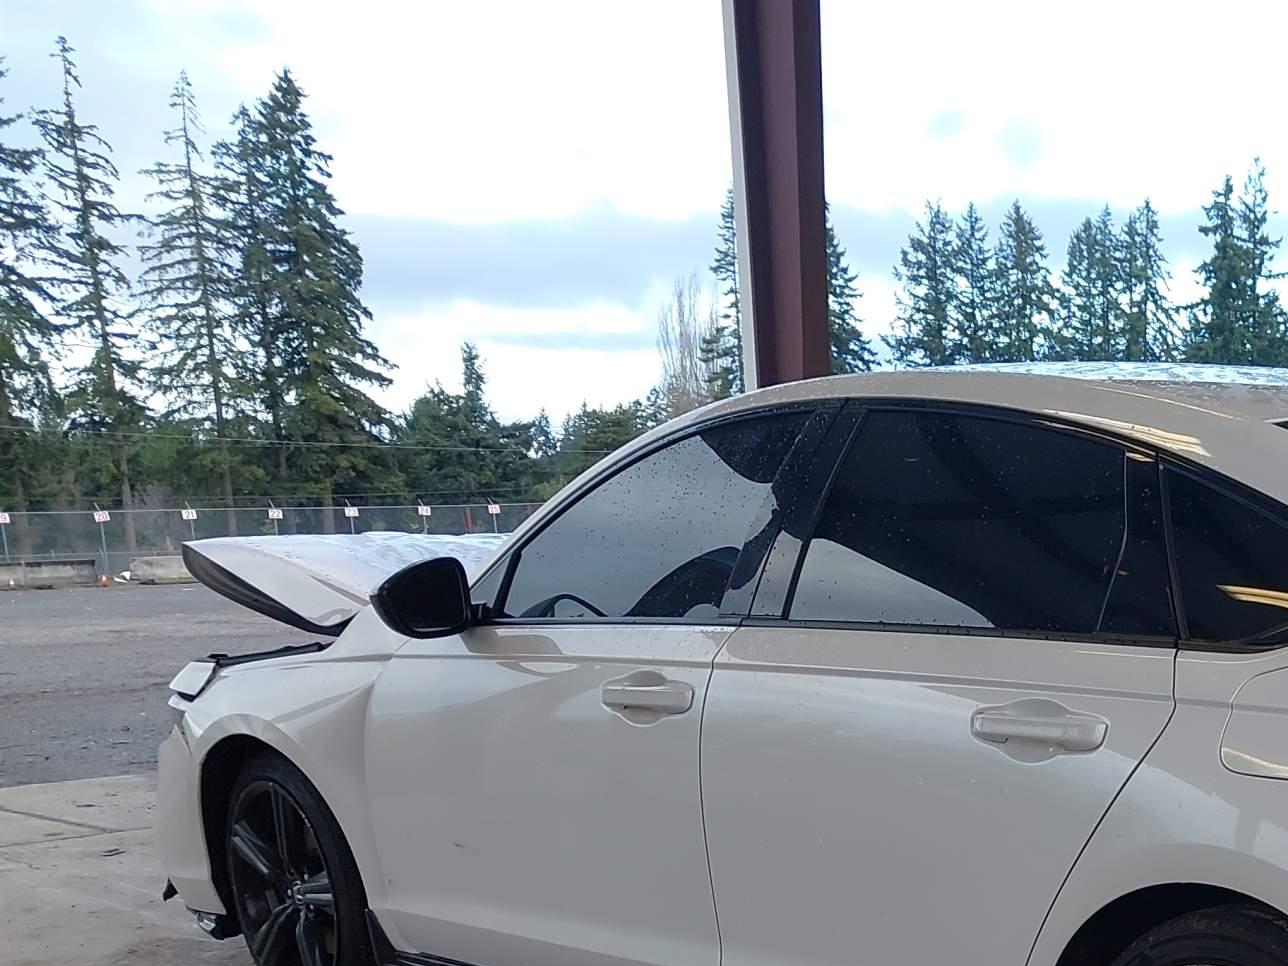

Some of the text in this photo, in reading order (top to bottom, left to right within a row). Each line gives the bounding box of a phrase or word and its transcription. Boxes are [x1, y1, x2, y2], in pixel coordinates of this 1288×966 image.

[95, 511, 108, 521] 20
[184, 510, 195, 519] 21
[270, 510, 281, 518] 22
